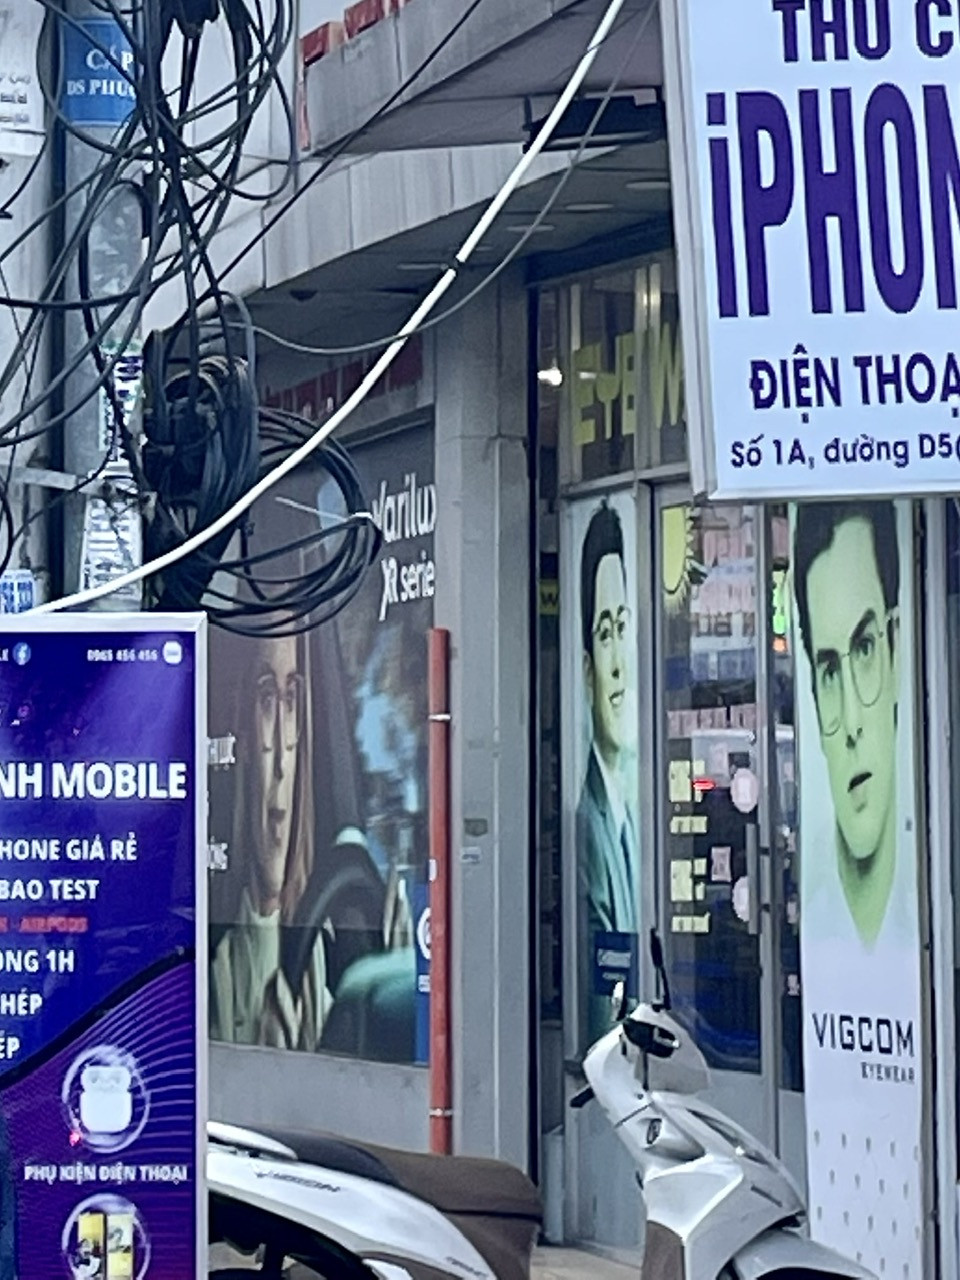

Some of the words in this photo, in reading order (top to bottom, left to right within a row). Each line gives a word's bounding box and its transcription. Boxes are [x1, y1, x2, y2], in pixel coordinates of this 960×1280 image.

[749, 343, 842, 423] ĐIỆN
[731, 434, 765, 468] Số
[772, 438, 815, 470] 1A,
[823, 433, 909, 469] đường
[52, 762, 187, 799] MOBILE
[66, 833, 105, 861] GIÁ
[110, 831, 139, 861] RẺ
[49, 879, 101, 900] TEST
[46, 950, 75, 972] 1H
[812, 1012, 915, 1058] VIGCOM
